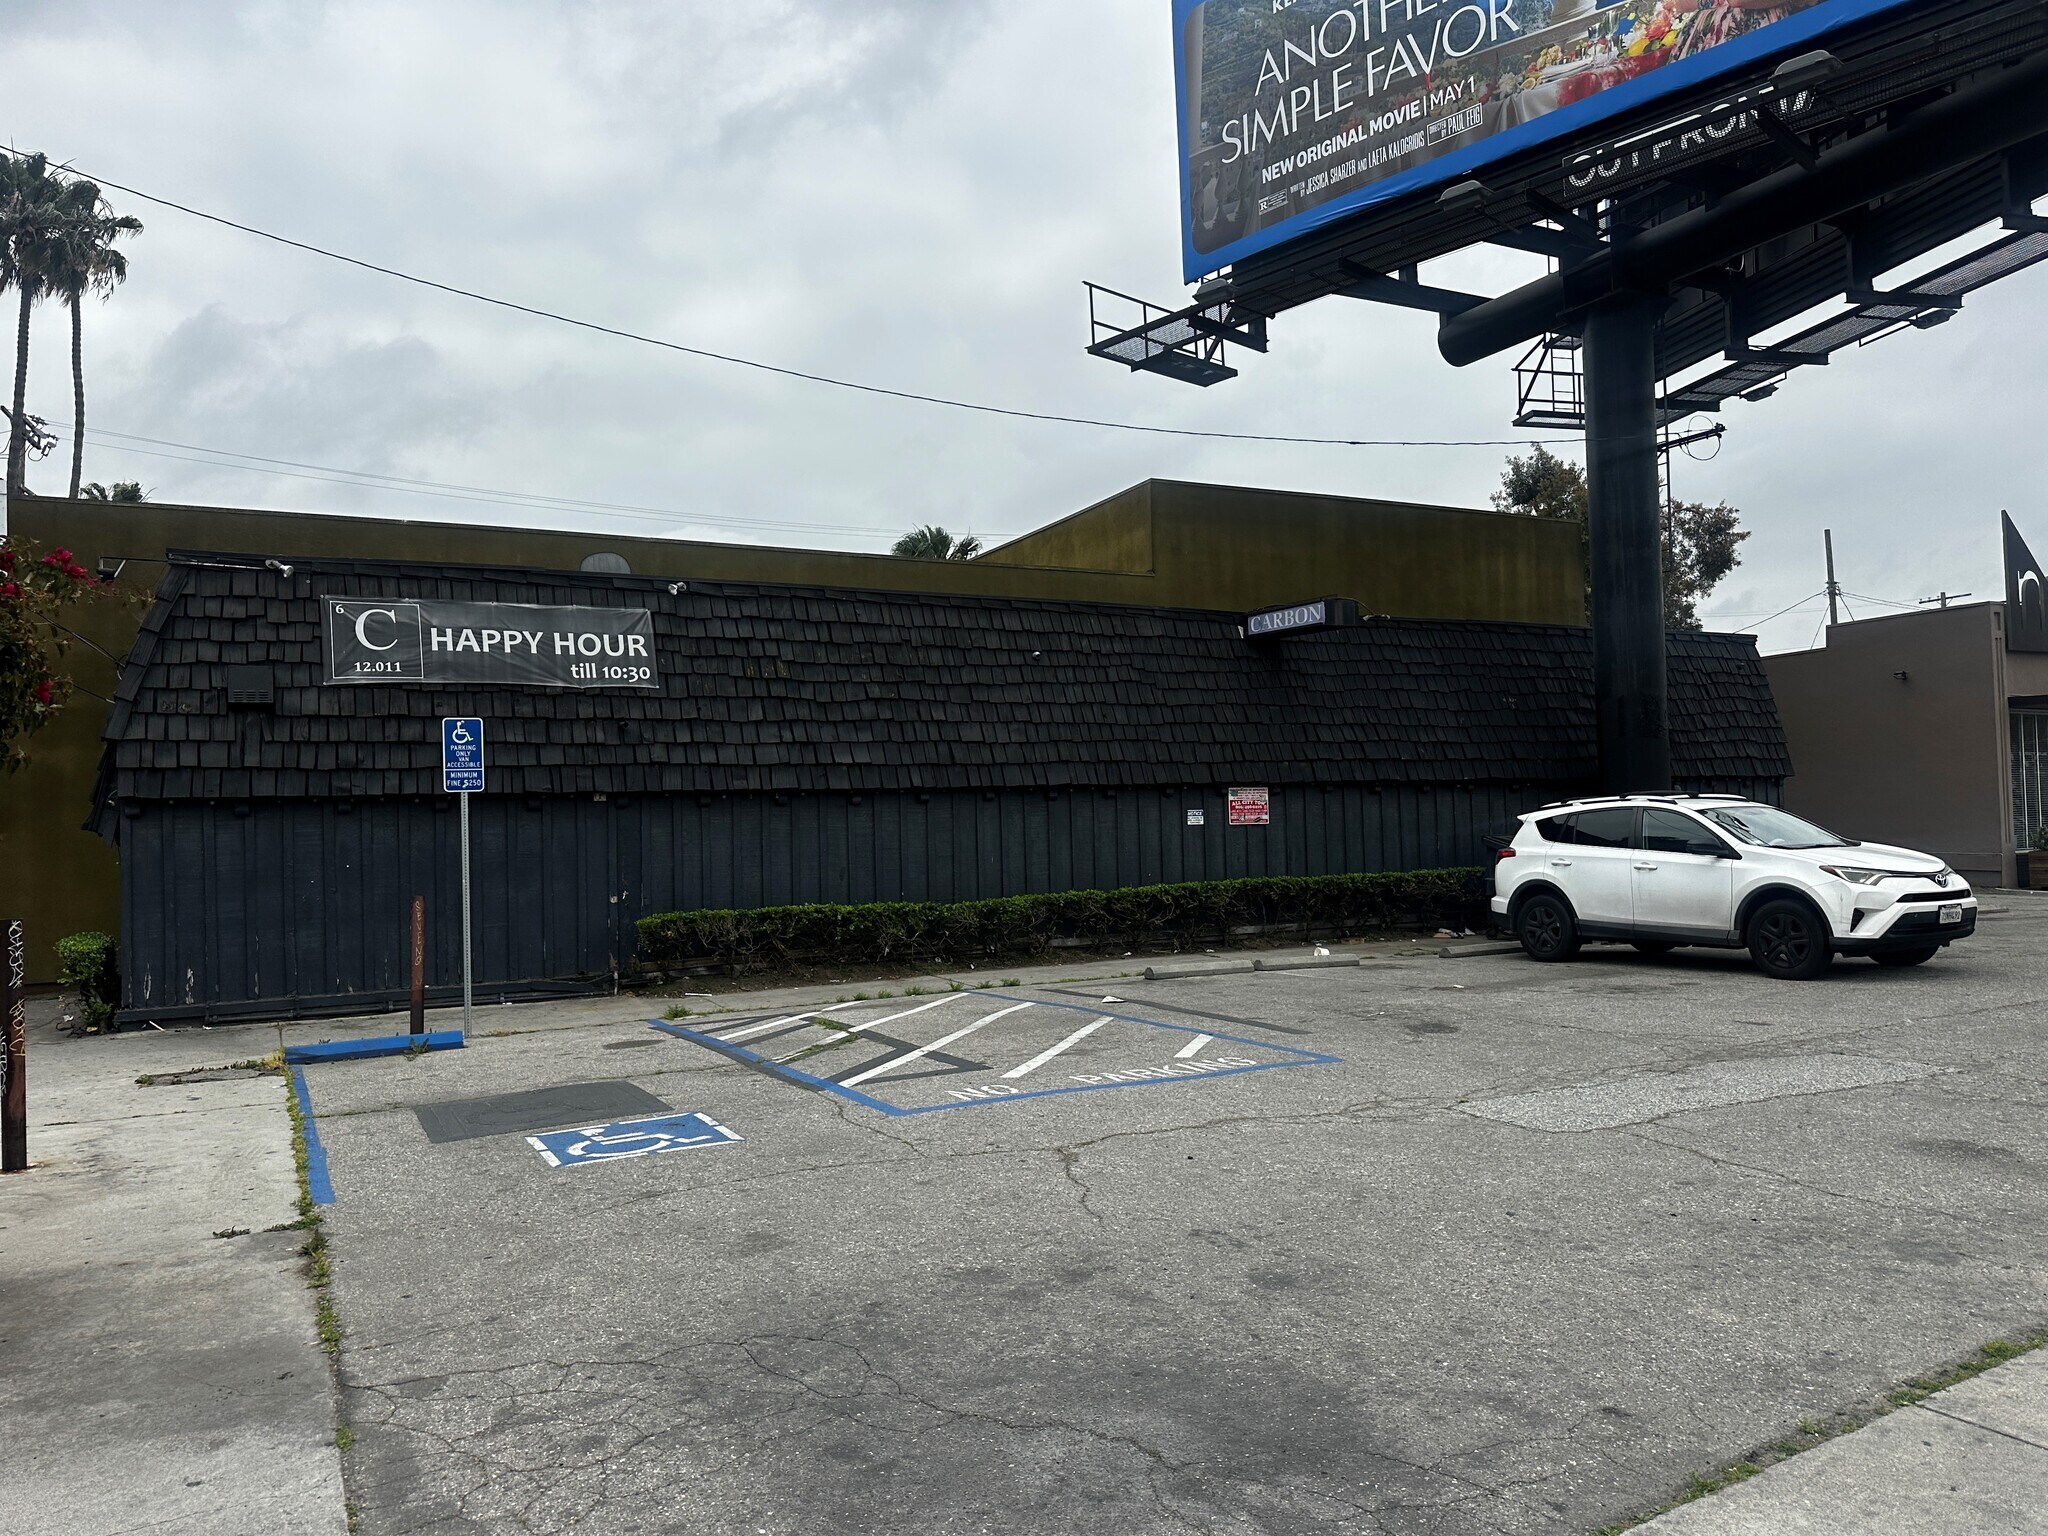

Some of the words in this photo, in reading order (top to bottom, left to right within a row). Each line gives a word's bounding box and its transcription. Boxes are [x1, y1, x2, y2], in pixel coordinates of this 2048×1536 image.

[1221, 62, 1353, 164] SIMPLE
[1367, 0, 1519, 97] FAVOR
[1262, 155, 1297, 184] NEW
[1296, 126, 1367, 168] ORIGINAL
[1369, 100, 1421, 137] MOVIE
[1428, 80, 1467, 110] MAY
[1466, 76, 1475, 93] 1
[1448, 112, 1465, 135] PAUL
[1466, 106, 1480, 128] FEIG
[1306, 171, 1329, 195] JESSICA
[1330, 159, 1356, 184] SHARZER
[1357, 157, 1368, 173] AND
[1368, 146, 1388, 169] LAETA
[1259, 202, 1268, 211] R
[335, 604, 344, 614] 6
[1250, 604, 1321, 632] CARBON
[354, 608, 398, 651] C
[430, 627, 544, 654] HAPPY
[554, 633, 648, 657] HOUR
[354, 661, 402, 673] 12.011
[571, 663, 597, 679] till
[602, 665, 650, 682] 10:30
[463, 780, 482, 788] $250
[945, 1084, 1020, 1101] NO
